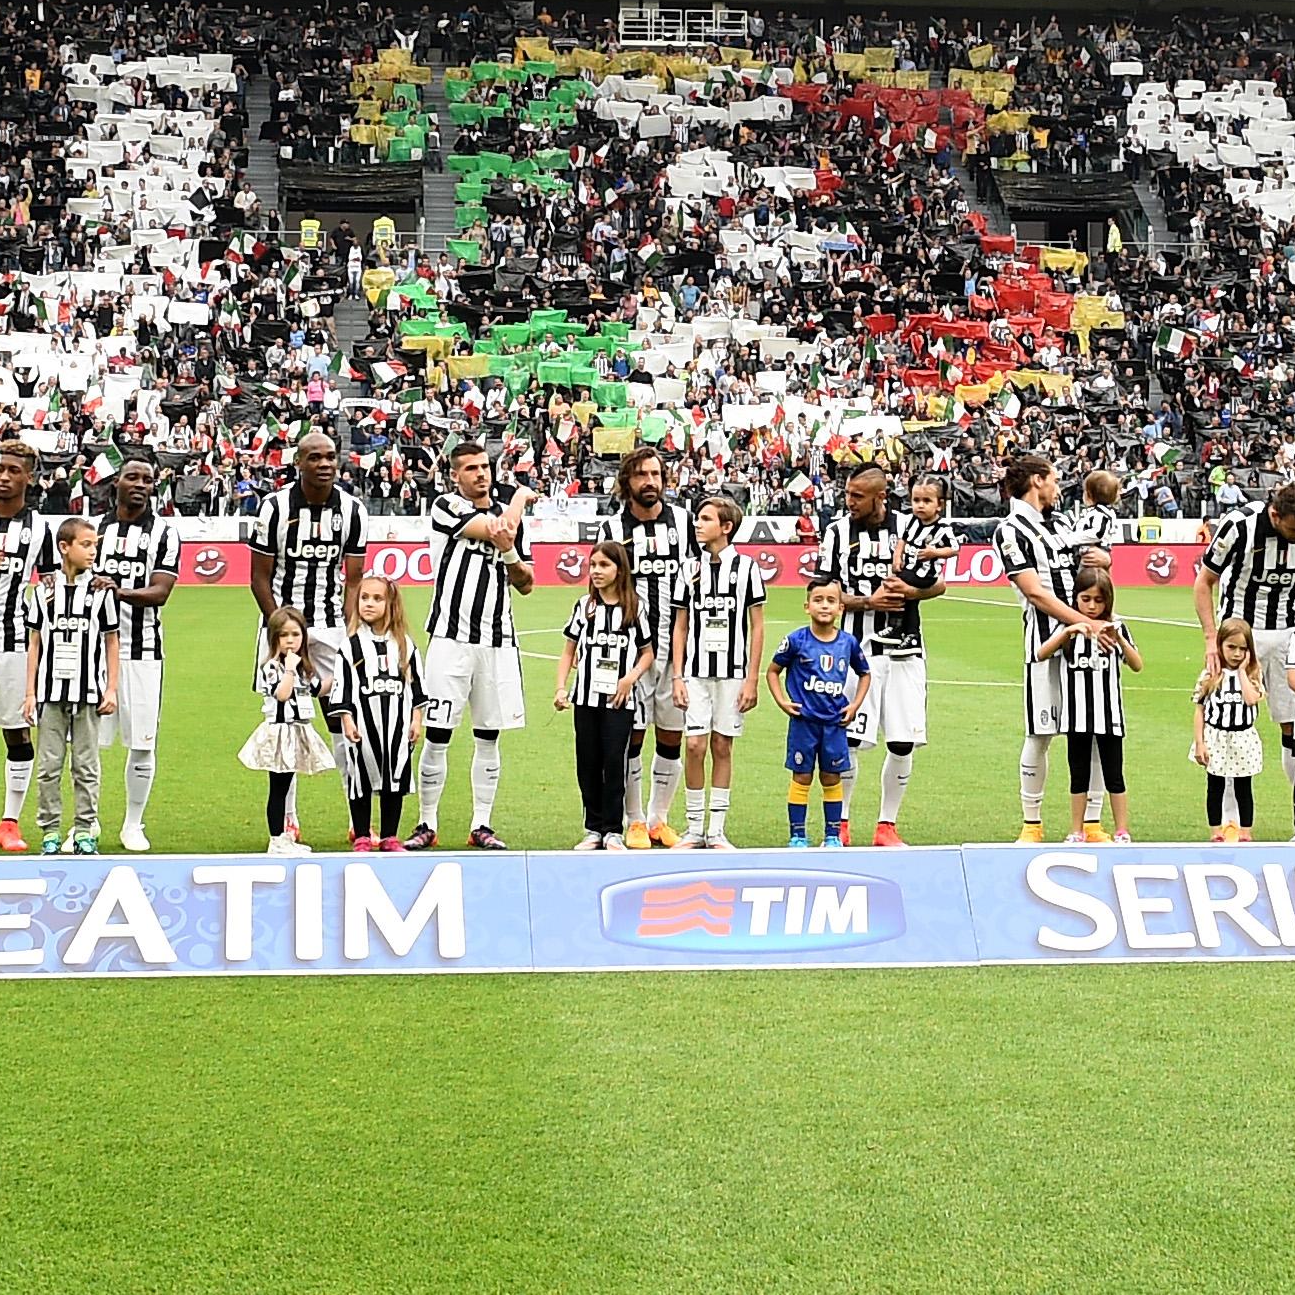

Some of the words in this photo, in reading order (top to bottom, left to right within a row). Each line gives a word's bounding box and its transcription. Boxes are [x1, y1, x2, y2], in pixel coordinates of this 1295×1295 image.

[287, 541, 340, 562] Jeep
[93, 558, 146, 581] Jeep
[632, 559, 679, 578] Jeep
[694, 594, 736, 611] Jeep
[49, 615, 90, 632] Jeep
[586, 631, 629, 649] Jeep
[361, 676, 404, 696] Jeep
[804, 675, 844, 698] Jeep
[1215, 689, 1243, 704] Jee
[426, 699, 453, 722] 27
[62, 862, 178, 966] A
[192, 861, 466, 964] TIM
[740, 885, 870, 937] TIM
